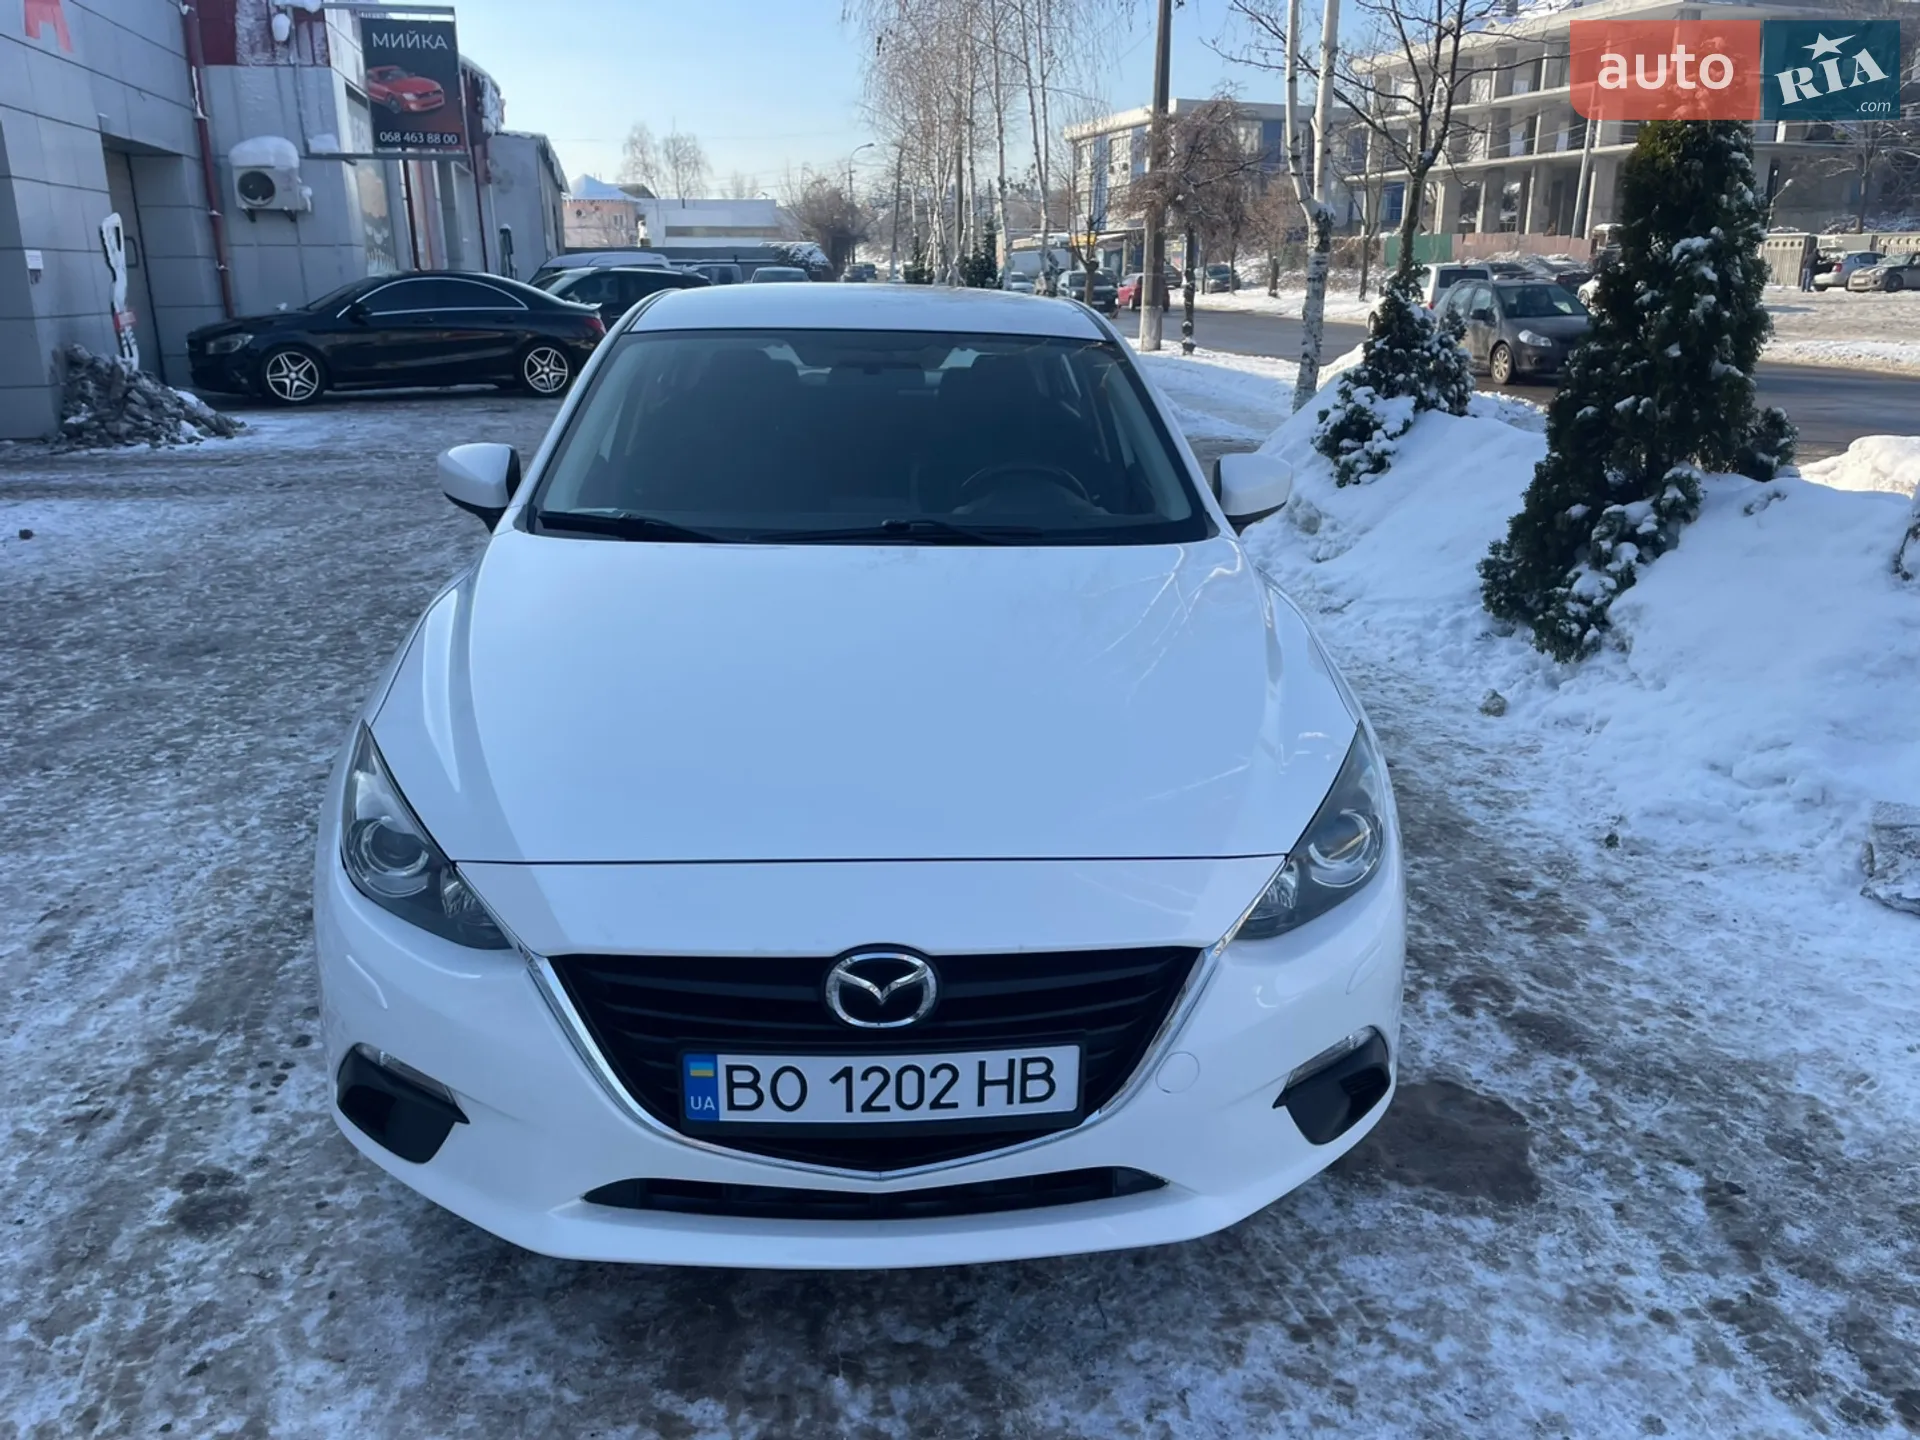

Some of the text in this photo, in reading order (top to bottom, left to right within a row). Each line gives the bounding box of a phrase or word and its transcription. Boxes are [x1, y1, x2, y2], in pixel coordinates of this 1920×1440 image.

[372, 30, 448, 49] МИЙКА
[380, 131, 458, 145] 068 463 88 00
[725, 1056, 1057, 1113] BO 1202 HB
[690, 1096, 716, 1111] UA
